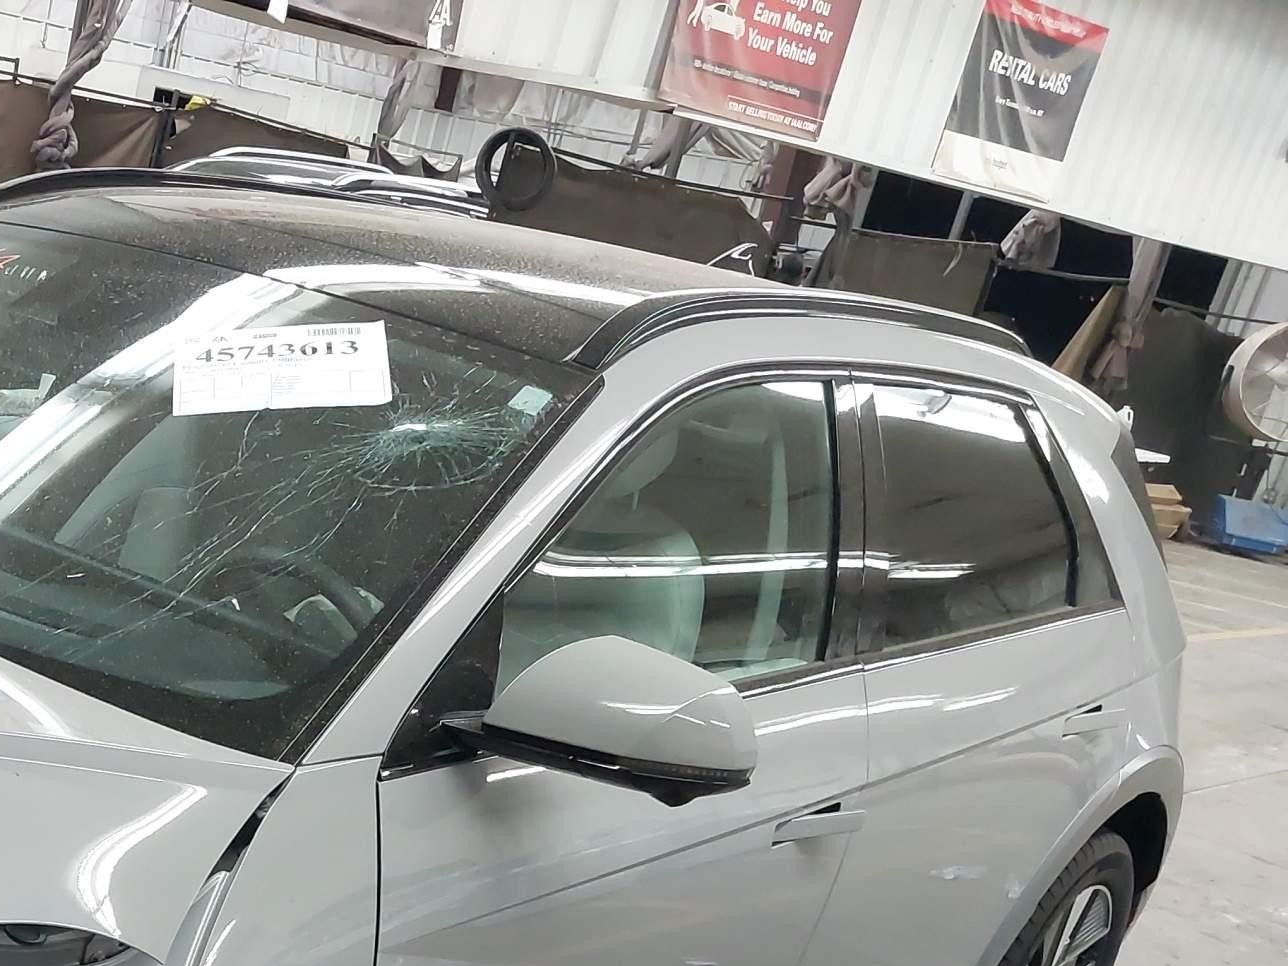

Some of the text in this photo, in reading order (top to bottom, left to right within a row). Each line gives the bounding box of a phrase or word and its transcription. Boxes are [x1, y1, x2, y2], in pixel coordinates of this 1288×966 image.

[753, 1, 834, 44] Earn More For
[810, 0, 831, 16] You
[747, 26, 817, 66] Your Vehicle
[988, 49, 1072, 96] RENTAL CARS
[195, 340, 360, 363] 45743613
